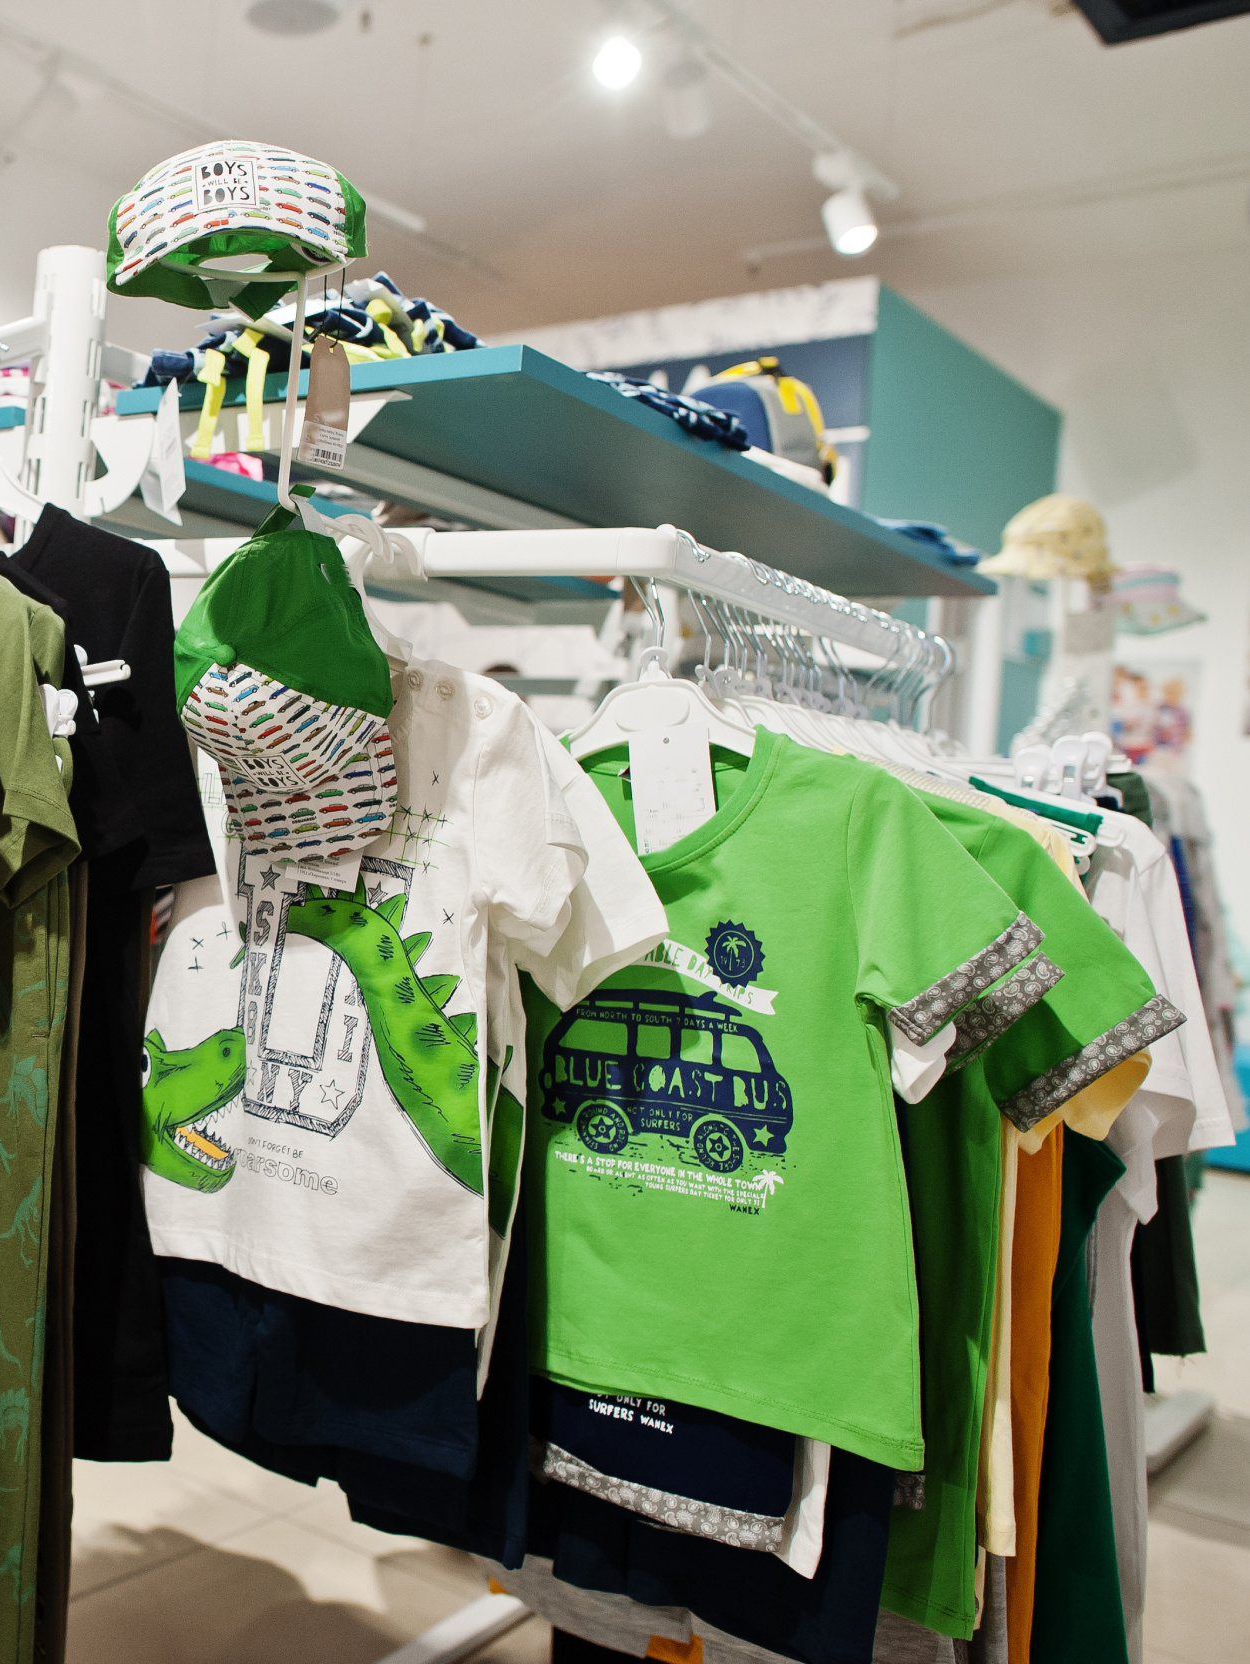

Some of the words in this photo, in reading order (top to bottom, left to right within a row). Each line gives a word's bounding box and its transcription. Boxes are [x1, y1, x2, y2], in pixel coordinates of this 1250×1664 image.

[201, 161, 248, 180] BOYS
[207, 178, 228, 186] WILL
[203, 186, 250, 205] BOYS
[242, 758, 284, 770] BOYS
[257, 776, 298, 787] BOYS
[644, 941, 684, 968] ABLE
[687, 953, 714, 979] DAY
[719, 982, 754, 1005] RIPS
[576, 1008, 597, 1018] FROM
[599, 1010, 628, 1020] NORTH
[631, 1012, 642, 1022] TO
[644, 1014, 672, 1024] SOUTH
[684, 1017, 706, 1029] DAYS
[708, 1021, 714, 1029] A
[717, 1022, 739, 1033] WEEK
[555, 1054, 622, 1091] BLUE
[632, 1063, 724, 1103] COAST
[733, 1075, 788, 1110] BUS
[626, 1106, 645, 1115] NOT
[649, 1108, 673, 1118] ONLY
[676, 1111, 694, 1122] FOR
[640, 1117, 681, 1132] SURFERS
[262, 1140, 291, 1155] FORGET
[292, 1149, 304, 1159] BE
[587, 1156, 593, 1165] A
[595, 1156, 616, 1168] STOP
[617, 1160, 633, 1171] FOR
[634, 1161, 676, 1177] EVERYONE
[677, 1169, 686, 1179] IN
[687, 1170, 703, 1182] THE
[705, 1173, 733, 1188] WHOLE
[735, 1178, 761, 1190] TOWN
[637, 1173, 645, 1181] AS
[646, 1175, 666, 1183] OFTEN
[676, 1179, 688, 1187] YOU
[688, 1182, 706, 1190] WANT
[707, 1185, 722, 1194] WITH
[723, 1188, 734, 1196] THE
[645, 1182, 664, 1191] YOUNG
[665, 1184, 689, 1195] SURFERS
[690, 1189, 702, 1197] DAY
[703, 1191, 723, 1201] TICKET
[724, 1195, 735, 1203] FOR
[736, 1197, 752, 1205] ONLY
[729, 1203, 760, 1215] WANEX
[616, 1395, 642, 1408] ONLY
[646, 1400, 666, 1416] FOR
[588, 1398, 635, 1422] SURFERS
[640, 1414, 674, 1435] WANEX
